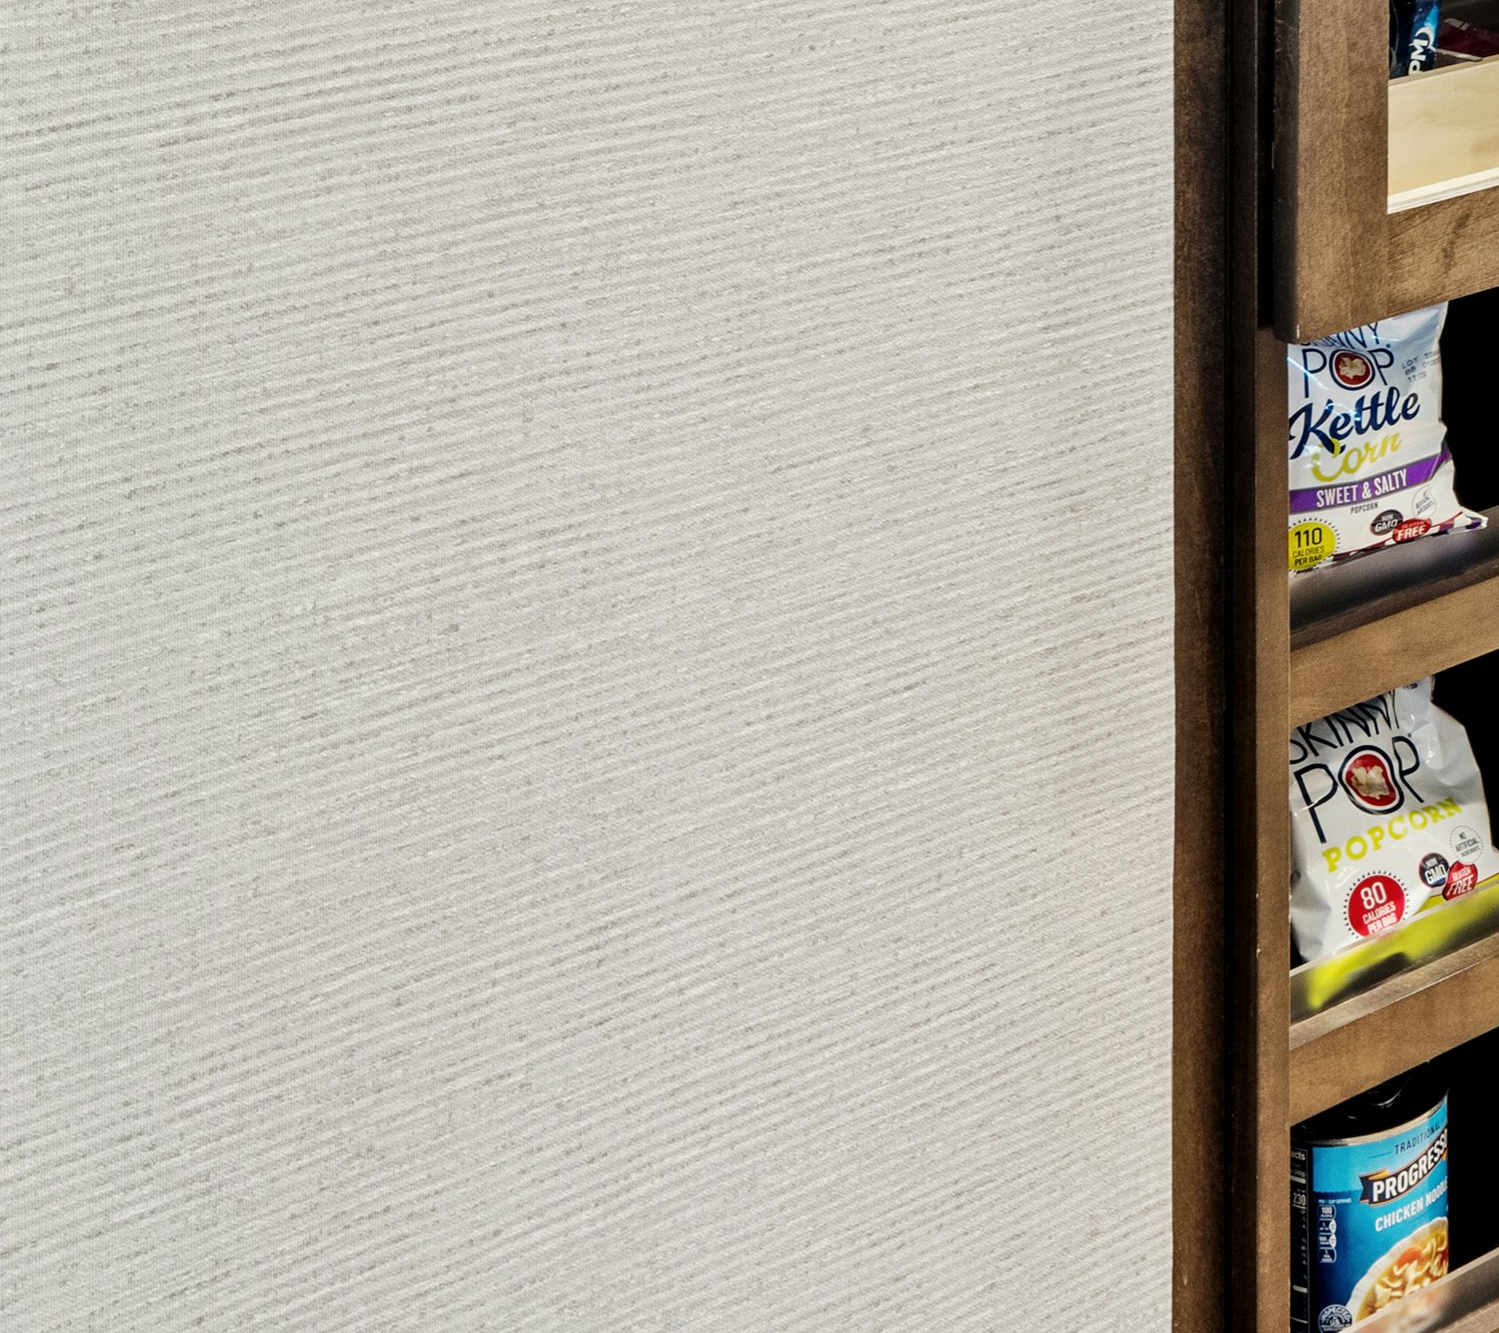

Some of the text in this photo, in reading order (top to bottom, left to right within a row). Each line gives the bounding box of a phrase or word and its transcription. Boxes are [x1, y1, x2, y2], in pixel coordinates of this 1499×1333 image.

[1301, 346, 1395, 399] POP
[1289, 386, 1421, 460] Kettle
[1311, 431, 1402, 483] Corn
[1316, 468, 1409, 508] SWEET & SALTY
[1350, 501, 1379, 515] POPCORN
[1374, 518, 1399, 533] GMO
[1396, 524, 1428, 542] FREE
[1294, 527, 1323, 548] 110
[1292, 545, 1326, 559] CALORIES
[1294, 556, 1308, 567] PER
[1293, 735, 1424, 844] POP
[1321, 796, 1463, 874] POPCORN
[1424, 863, 1447, 886] GMO
[1359, 881, 1387, 910] 80
[1446, 875, 1474, 898] FREE
[1362, 901, 1397, 925] CALORIES
[1367, 913, 1398, 935] PER BAG
[1374, 1196, 1425, 1233] CHICKEN
